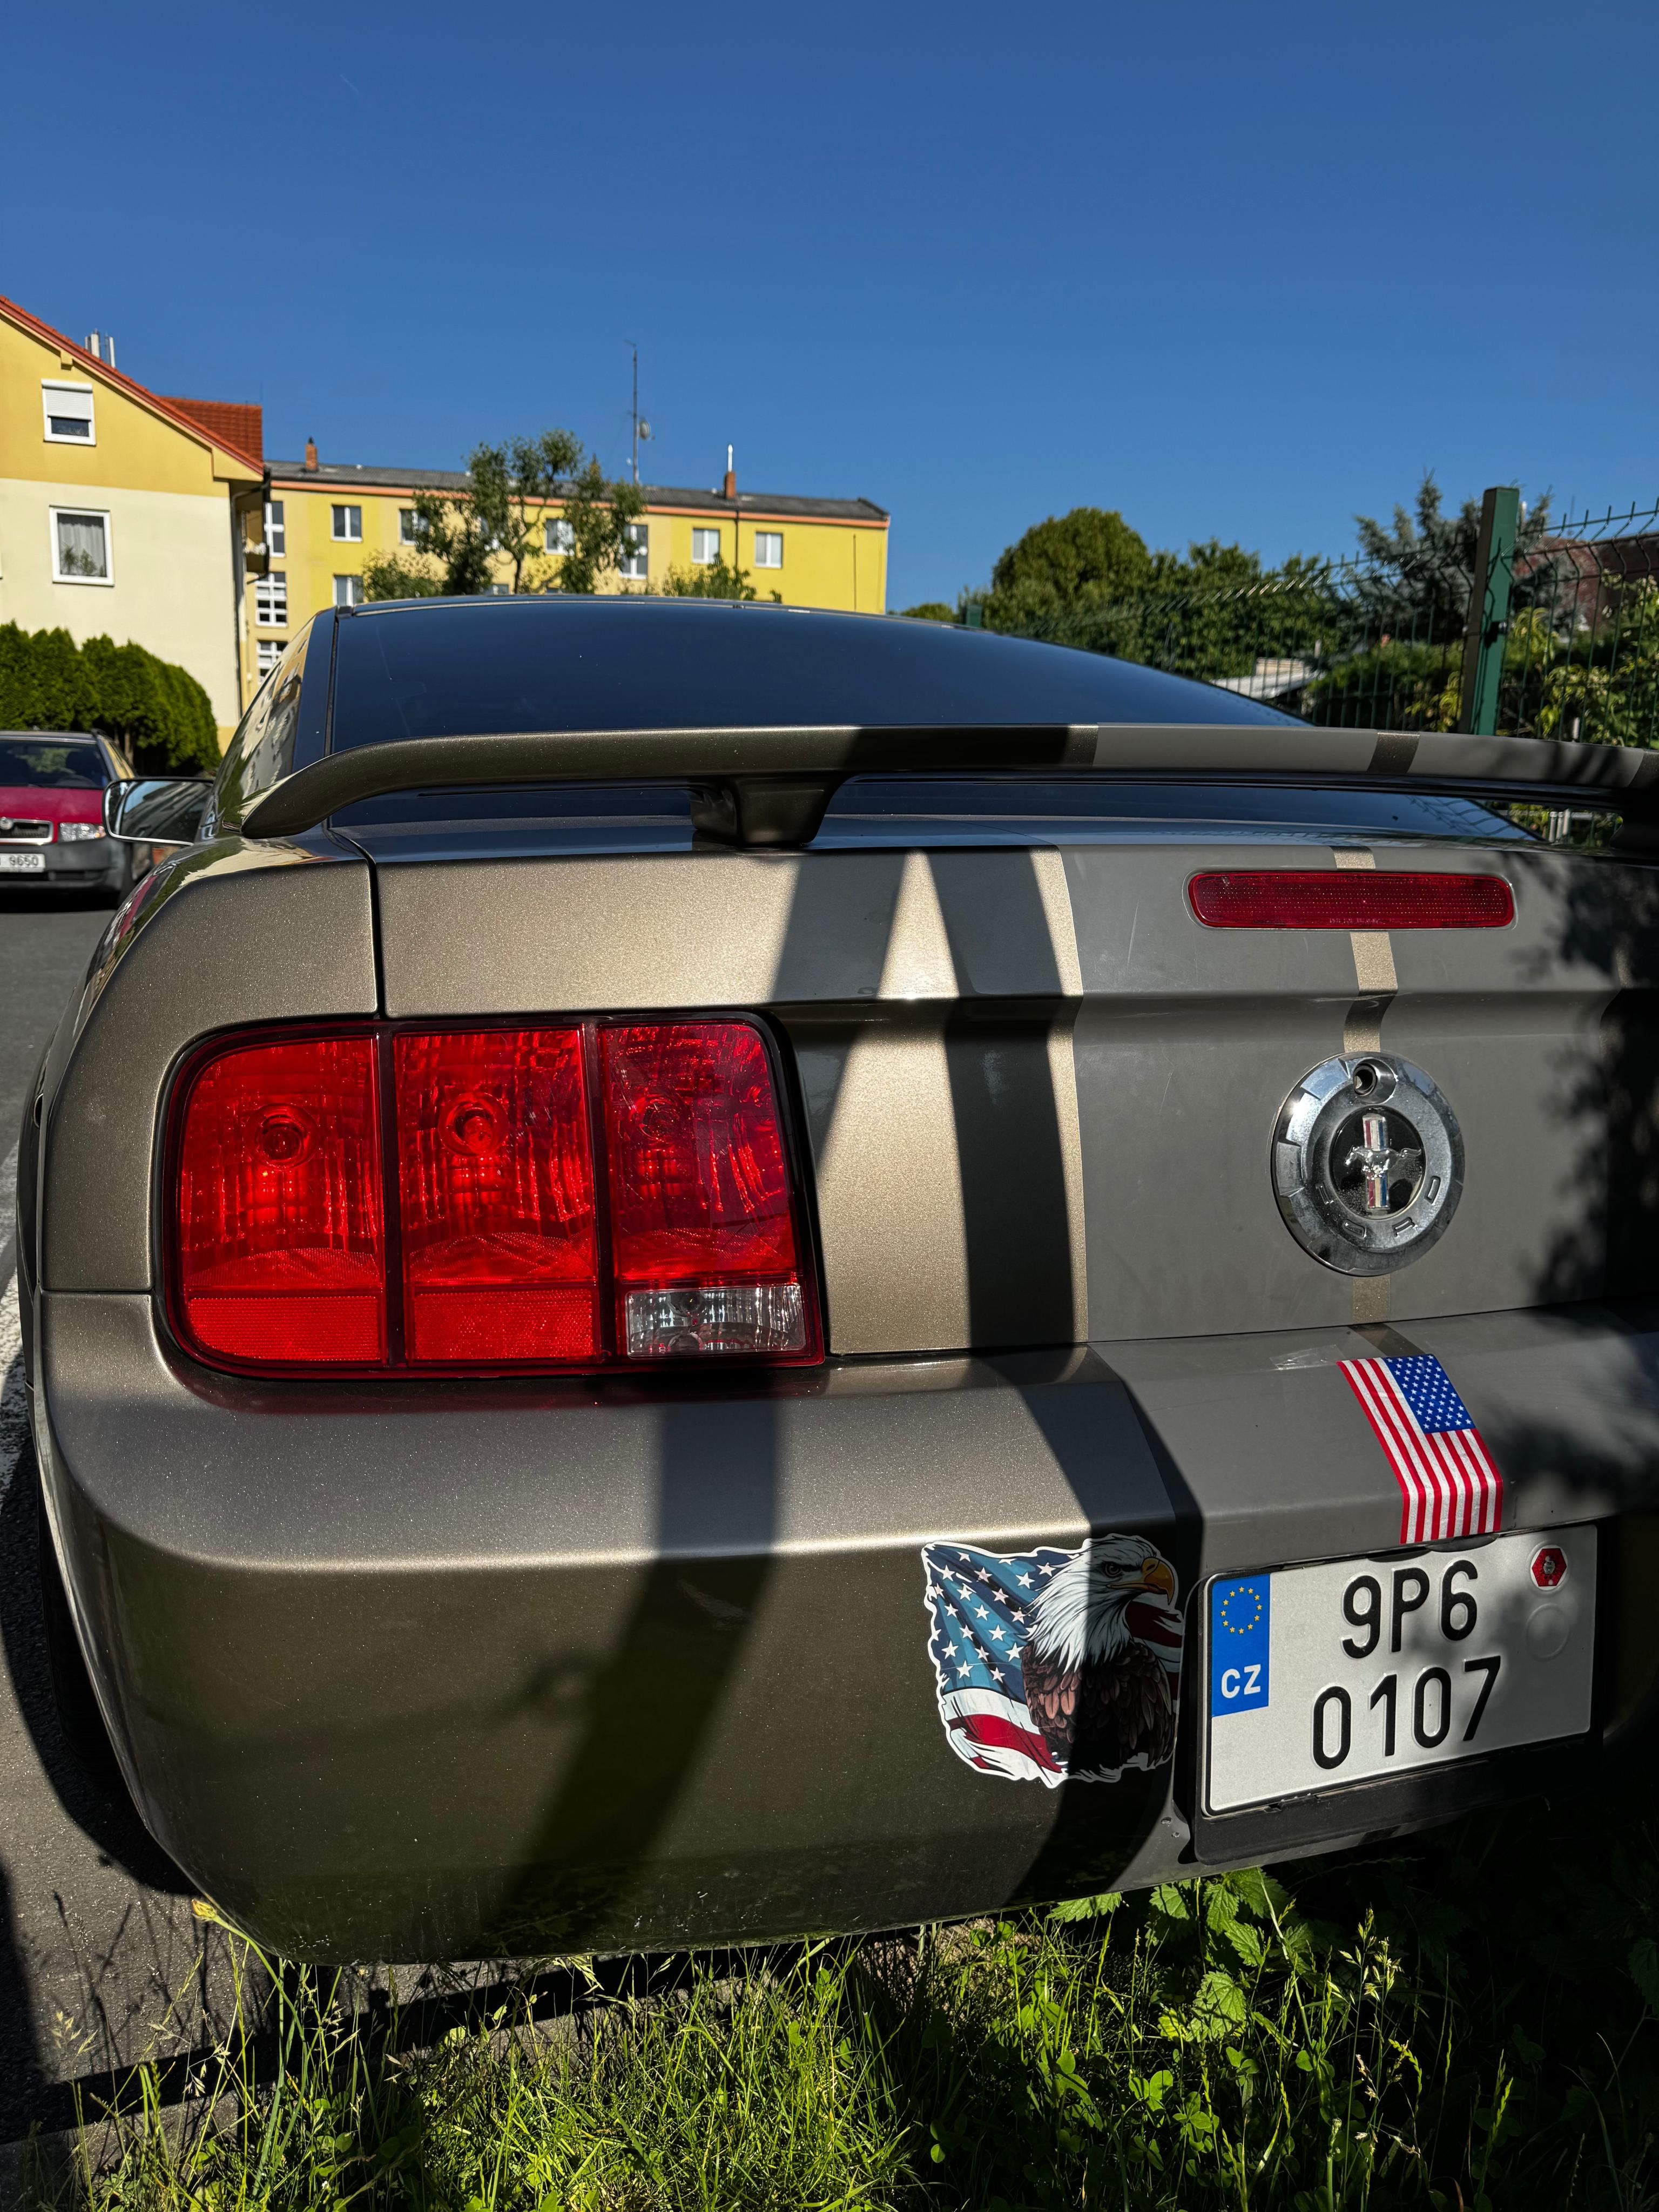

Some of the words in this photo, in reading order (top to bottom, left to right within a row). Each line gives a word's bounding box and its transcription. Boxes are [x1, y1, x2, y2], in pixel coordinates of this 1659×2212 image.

[1316, 1176, 1441, 1238] FORD
[1341, 1559, 1478, 1659] 9P6
[1220, 1663, 1262, 1699] CZ
[1312, 1655, 1501, 1770] 0107
